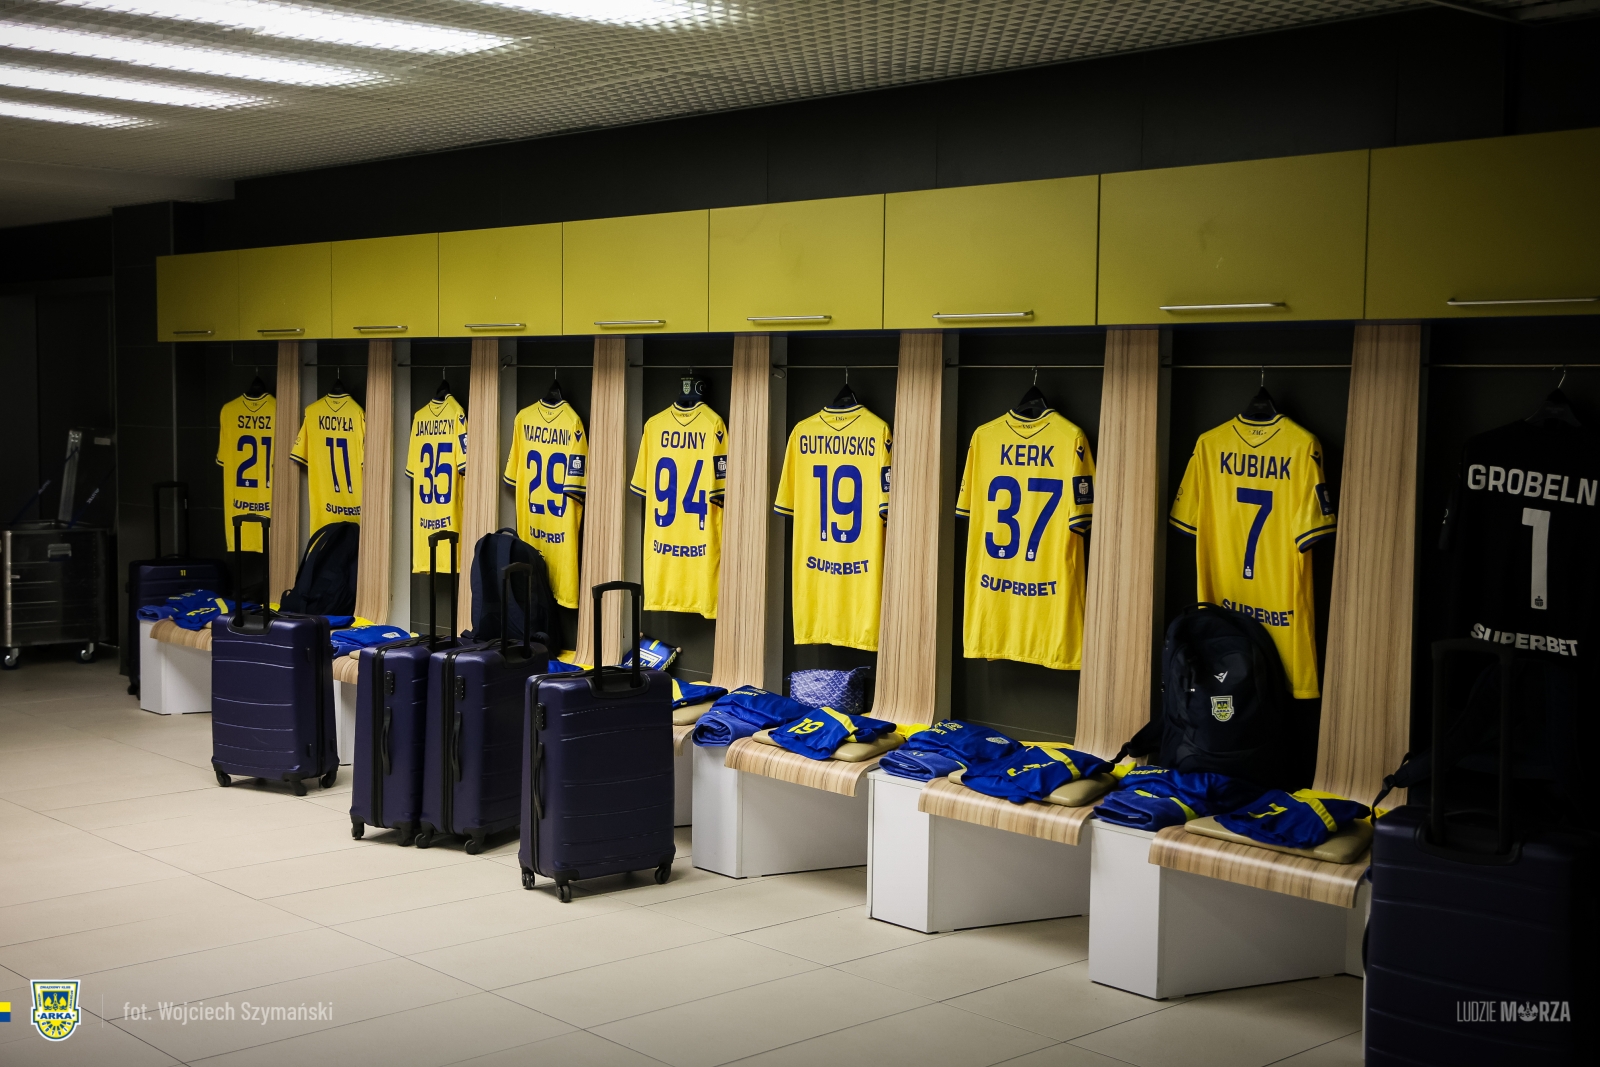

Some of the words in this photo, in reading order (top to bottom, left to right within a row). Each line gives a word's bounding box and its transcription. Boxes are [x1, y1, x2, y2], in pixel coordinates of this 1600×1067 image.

[237, 415, 272, 430] SZYSZ
[319, 415, 354, 432] KOCYŁA
[661, 430, 706, 449] GOJNY
[800, 435, 876, 456] GUTKOVSKIS
[236, 435, 272, 489] 21
[326, 437, 353, 493] 11
[1000, 444, 1055, 467] KERK
[1220, 451, 1292, 480] KUBIAK
[419, 442, 453, 505] 35
[527, 449, 568, 518] 29
[1467, 464, 1598, 506] GROBELN
[233, 498, 270, 512] UPERBE
[654, 457, 707, 530] 94
[813, 464, 863, 543] 19
[985, 475, 1063, 562] 37
[1236, 487, 1274, 580] 7
[653, 540, 706, 558] SUPERBET
[1521, 507, 1551, 610] 1
[806, 556, 869, 576] SUPERBET
[980, 574, 1057, 597] SUPERBET
[787, 718, 824, 735] 19
